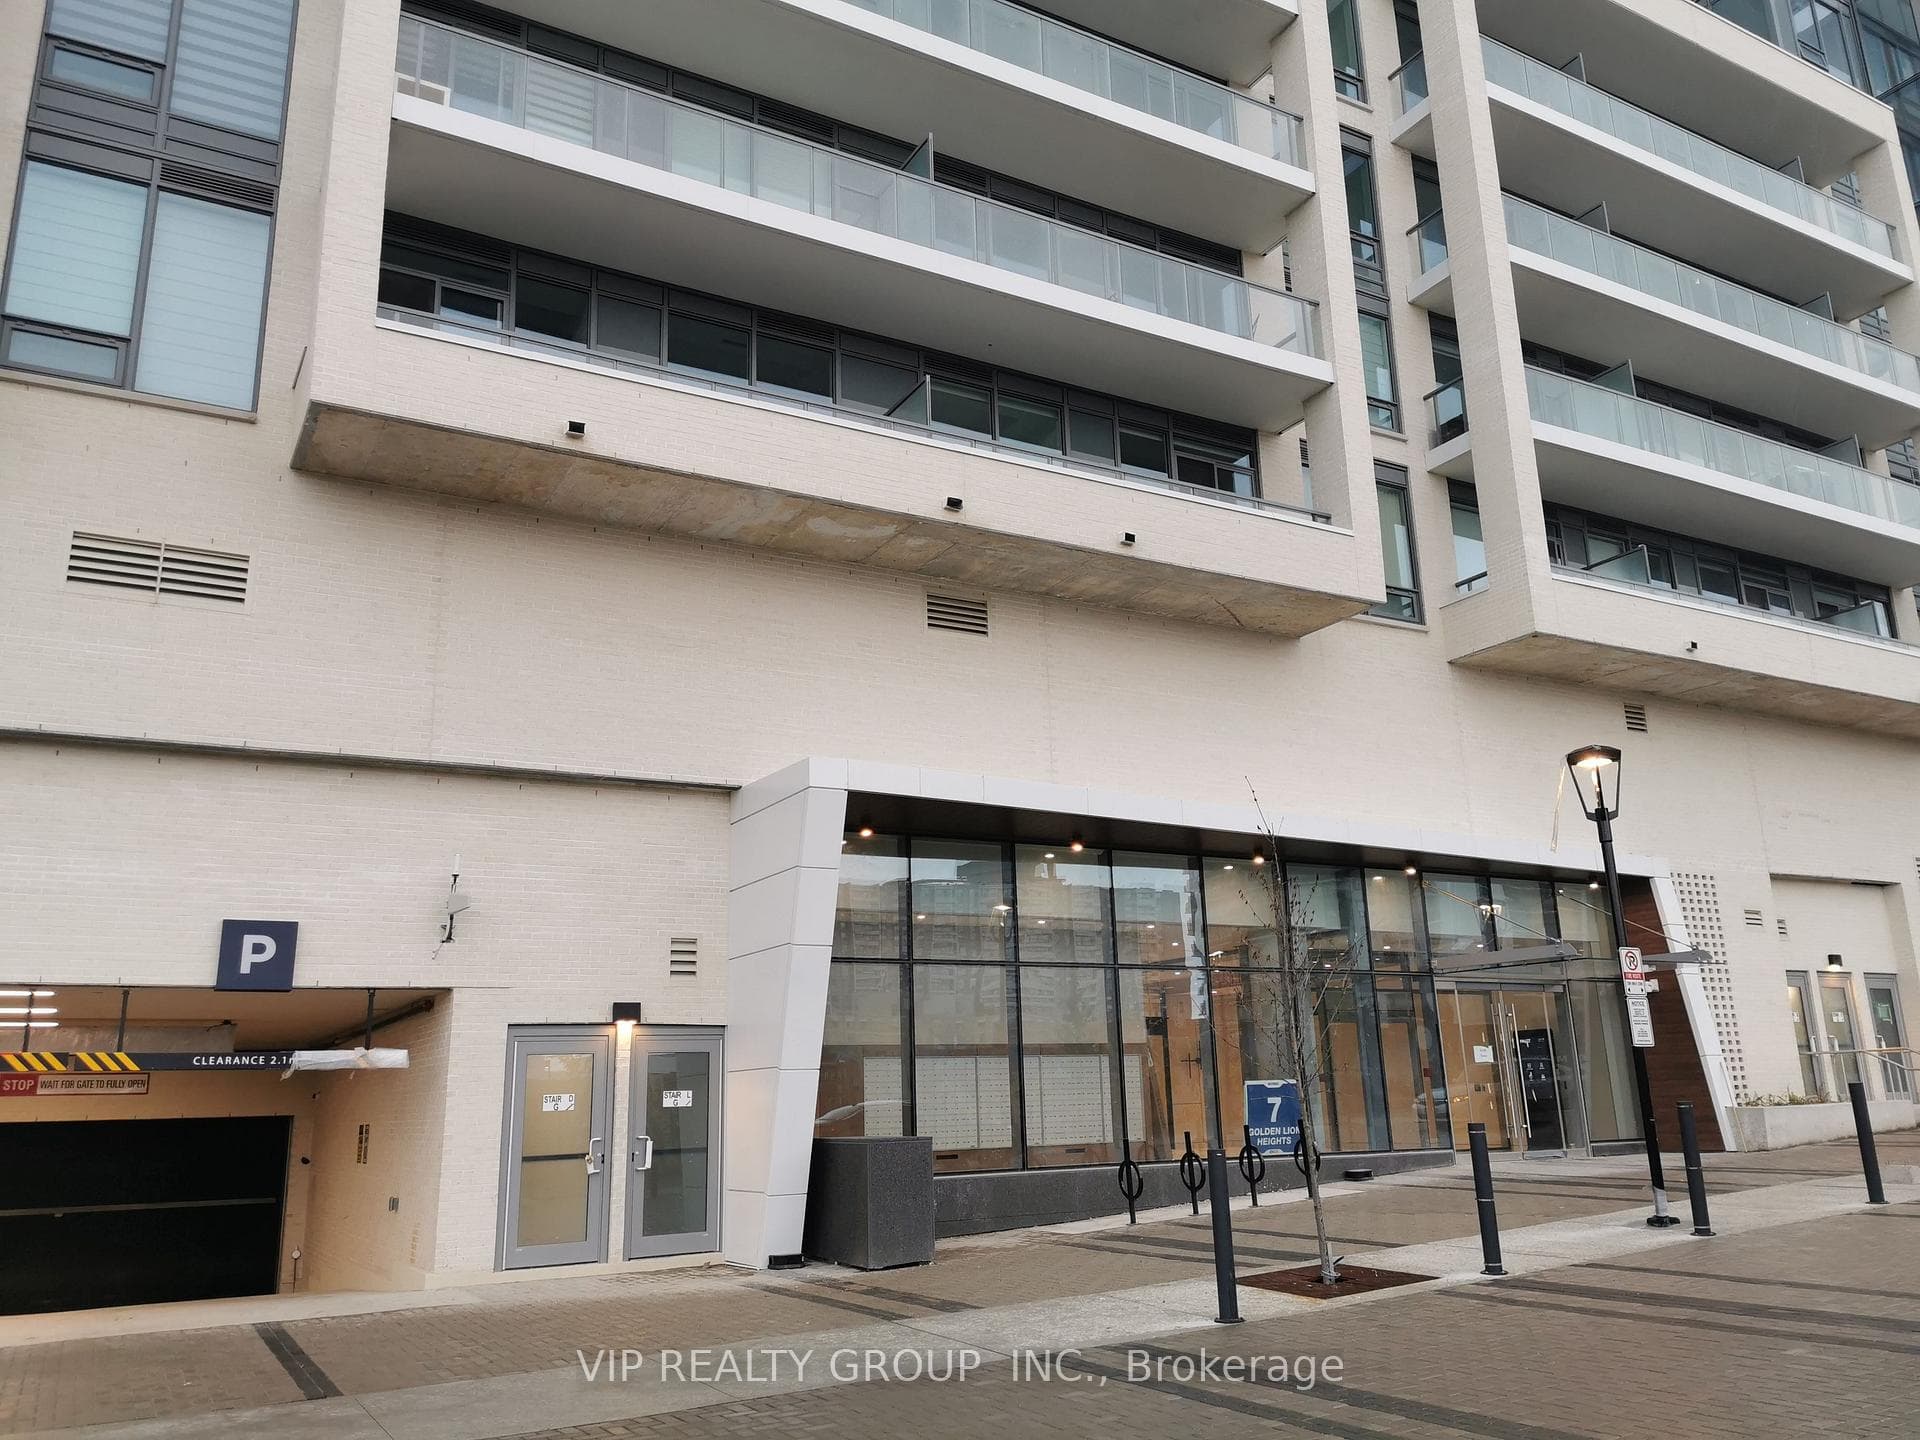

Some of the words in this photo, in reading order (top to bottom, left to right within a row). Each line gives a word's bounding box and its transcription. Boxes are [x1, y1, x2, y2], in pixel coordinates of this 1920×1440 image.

[239, 934, 277, 975] P
[193, 1056, 265, 1065] CLEARANCE
[3, 1080, 34, 1091] STOP
[40, 1080, 59, 1089] WAIT
[60, 1080, 75, 1089] FOR
[77, 1080, 96, 1089] GATE
[96, 1080, 105, 1089] TO
[106, 1080, 126, 1089] FULLY
[128, 1079, 146, 1088] OPEN
[1267, 1097, 1282, 1123] 7
[1249, 1127, 1280, 1136] GOLDEN
[1283, 1126, 1300, 1135] LION
[1257, 1137, 1292, 1146] HEIGHTS
